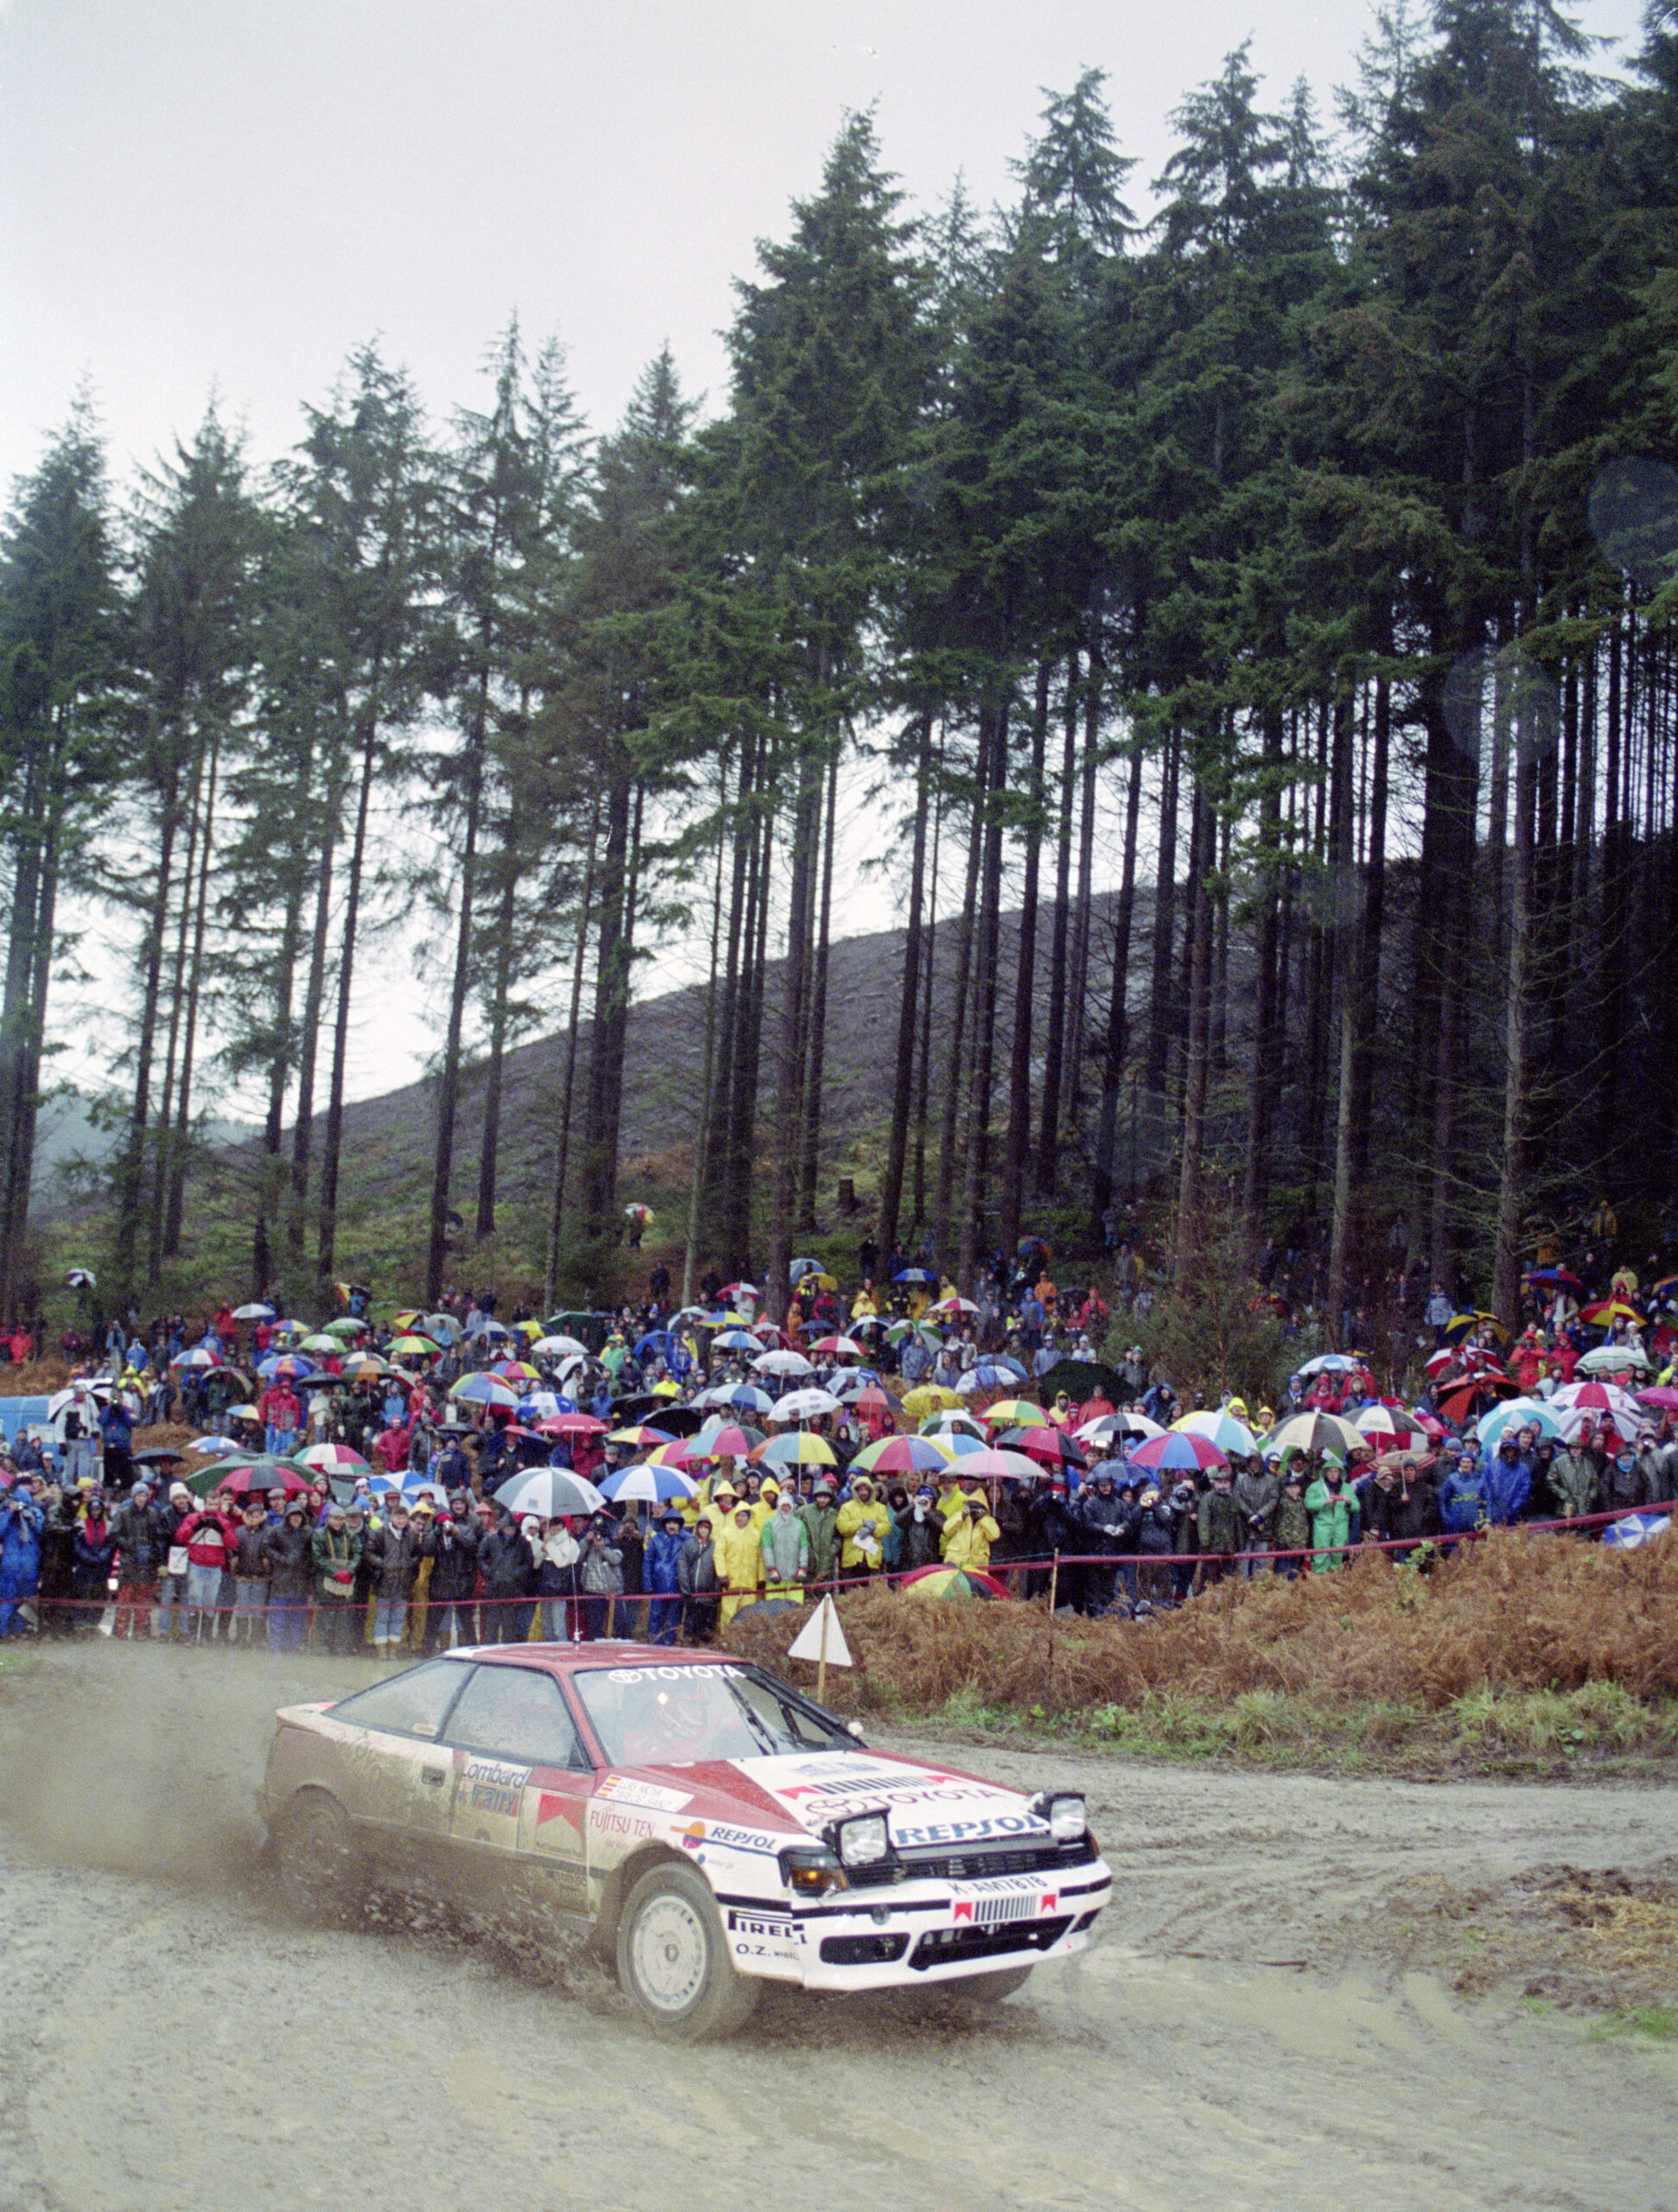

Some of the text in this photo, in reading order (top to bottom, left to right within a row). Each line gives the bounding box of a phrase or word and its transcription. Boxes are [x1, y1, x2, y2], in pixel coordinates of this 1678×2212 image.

[638, 1664, 747, 1681] TOYOTA
[867, 1789, 1003, 1807] TOYOTA
[589, 1810, 656, 1838] FUJITSU TEN
[894, 1815, 1044, 1845] REPSOL
[711, 1827, 778, 1850] REPSOL
[736, 1943, 771, 1956] O.Z.
